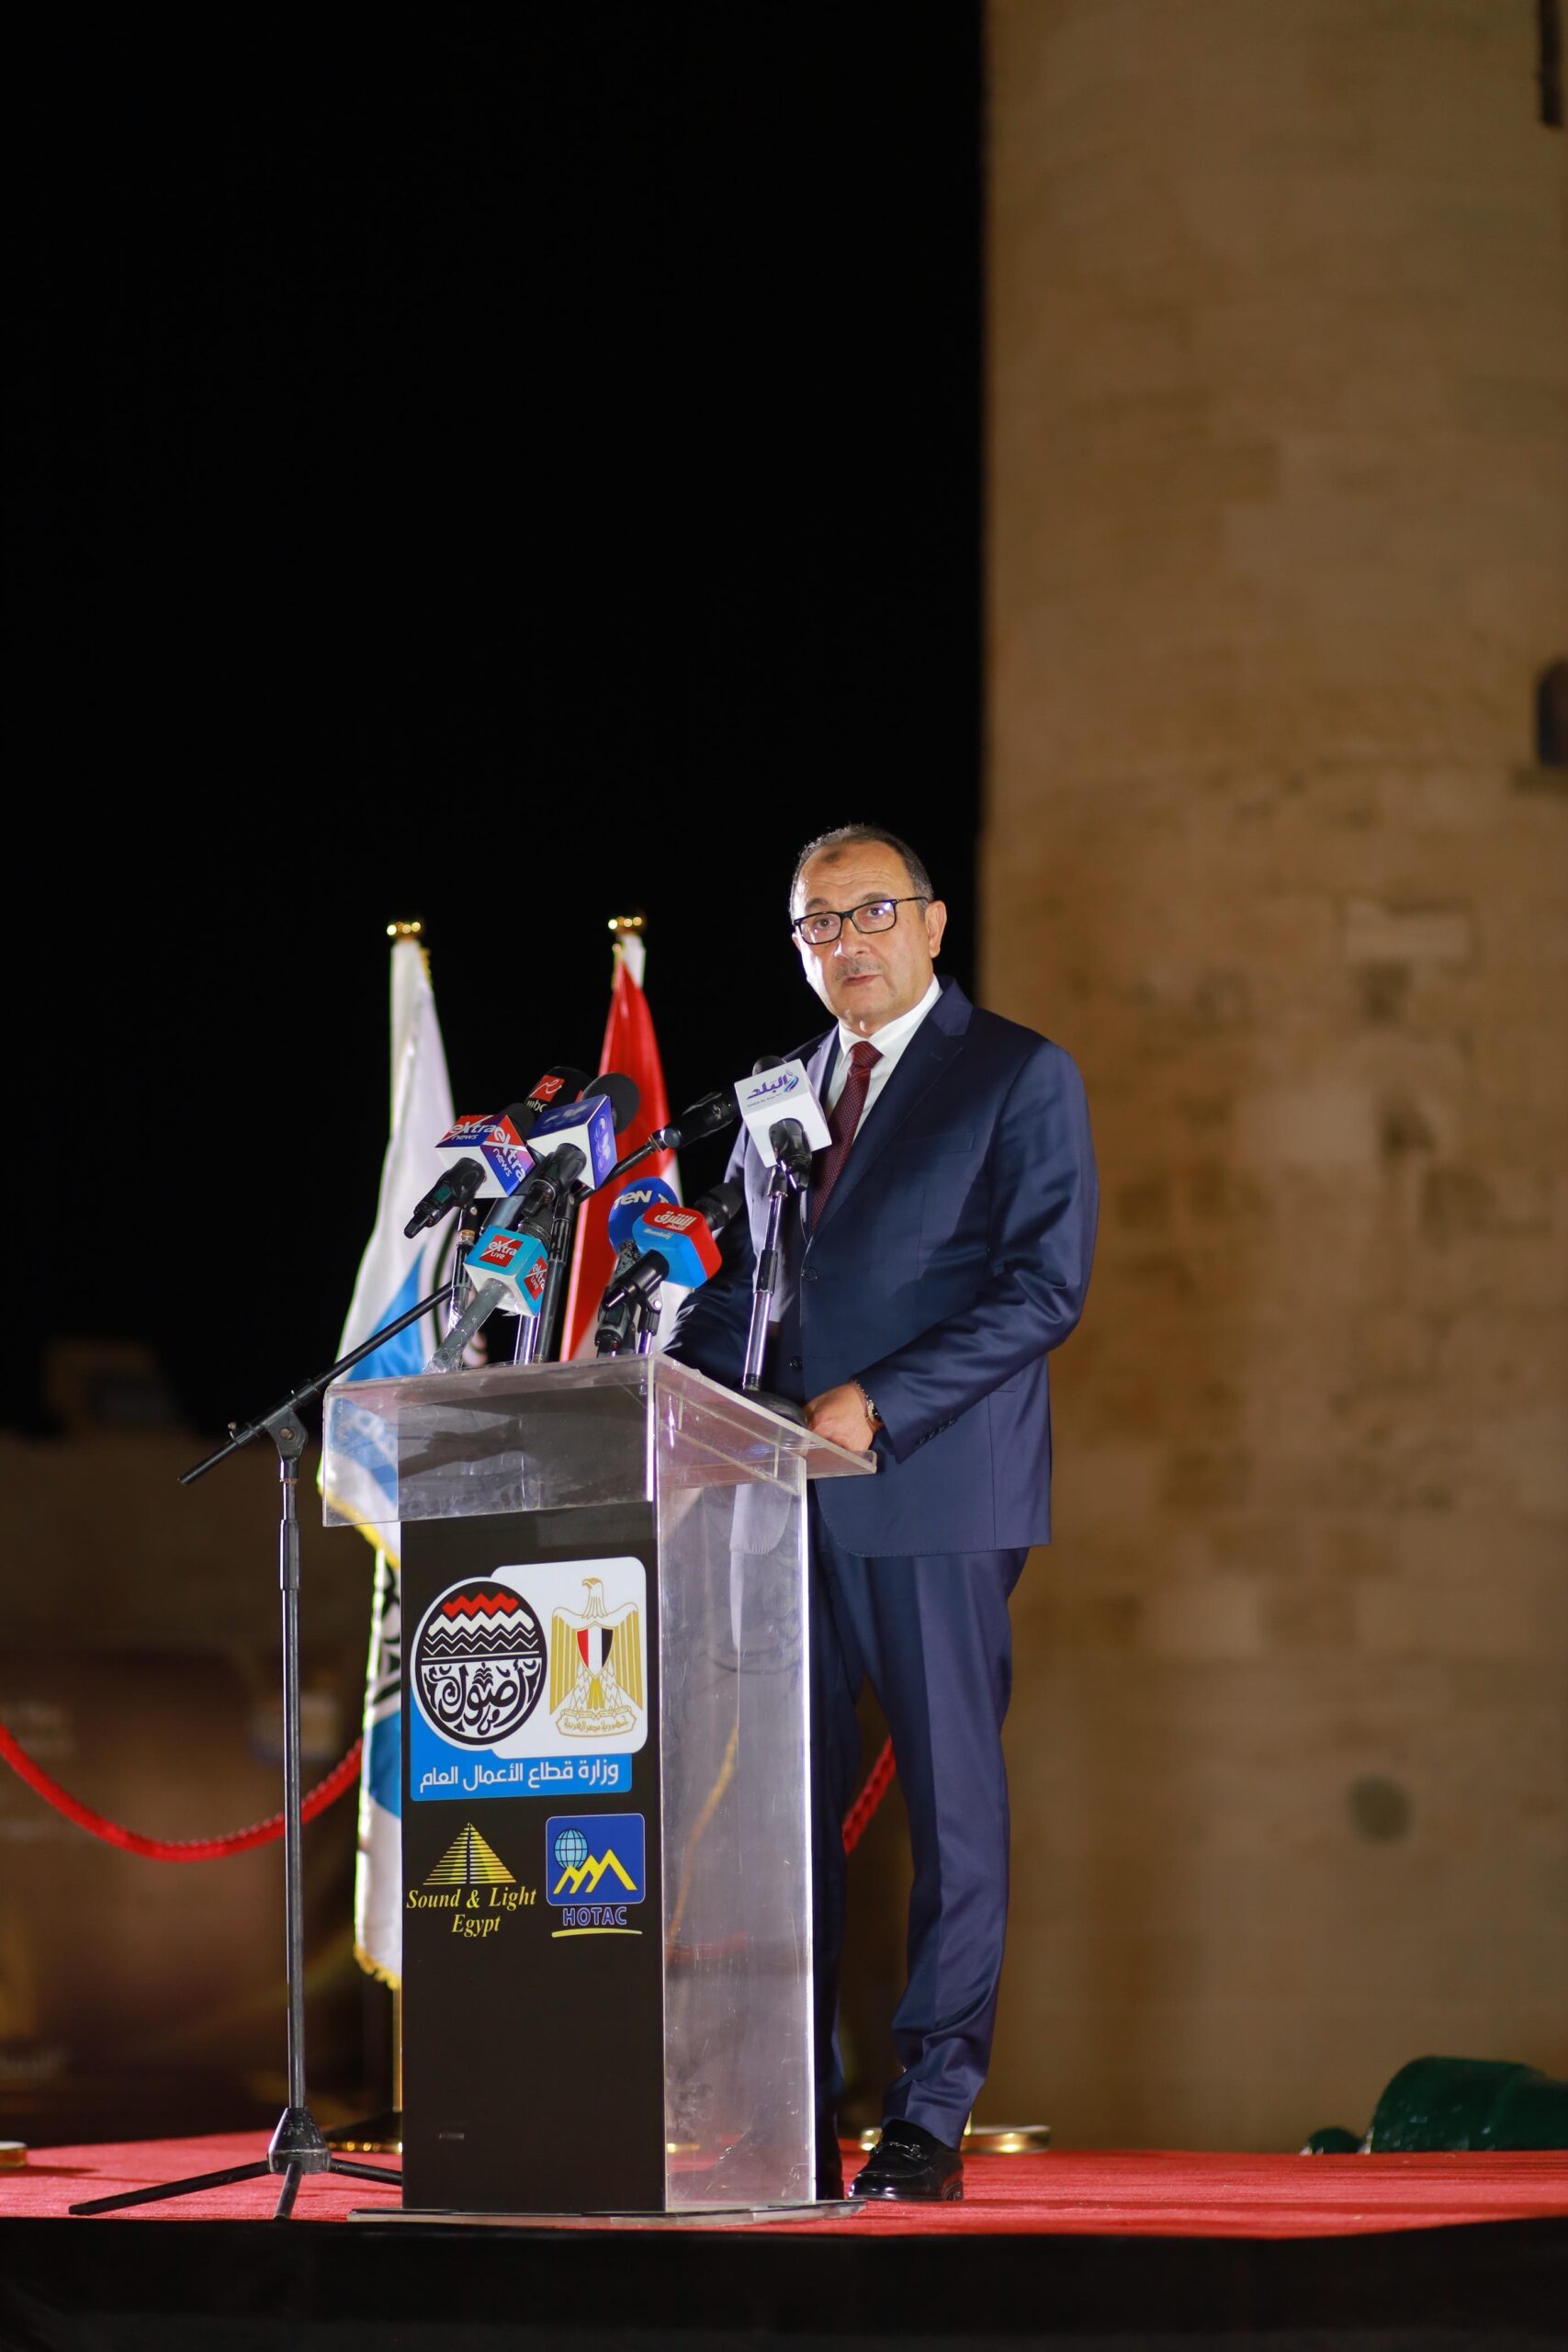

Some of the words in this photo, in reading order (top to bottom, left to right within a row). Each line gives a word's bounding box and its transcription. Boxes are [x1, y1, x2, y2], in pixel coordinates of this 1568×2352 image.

[492, 1148, 512, 1177] news
[420, 1766, 458, 1793] العام
[463, 1762, 524, 1792] الأعمال
[527, 1760, 573, 1789] قطاع
[578, 1758, 619, 1786] وزارة
[406, 1888, 461, 1909] Sound
[466, 1889, 480, 1909] &
[489, 1886, 537, 1912] Light
[451, 1914, 501, 1938] Egypt
[562, 1906, 627, 1927] HOTAC
